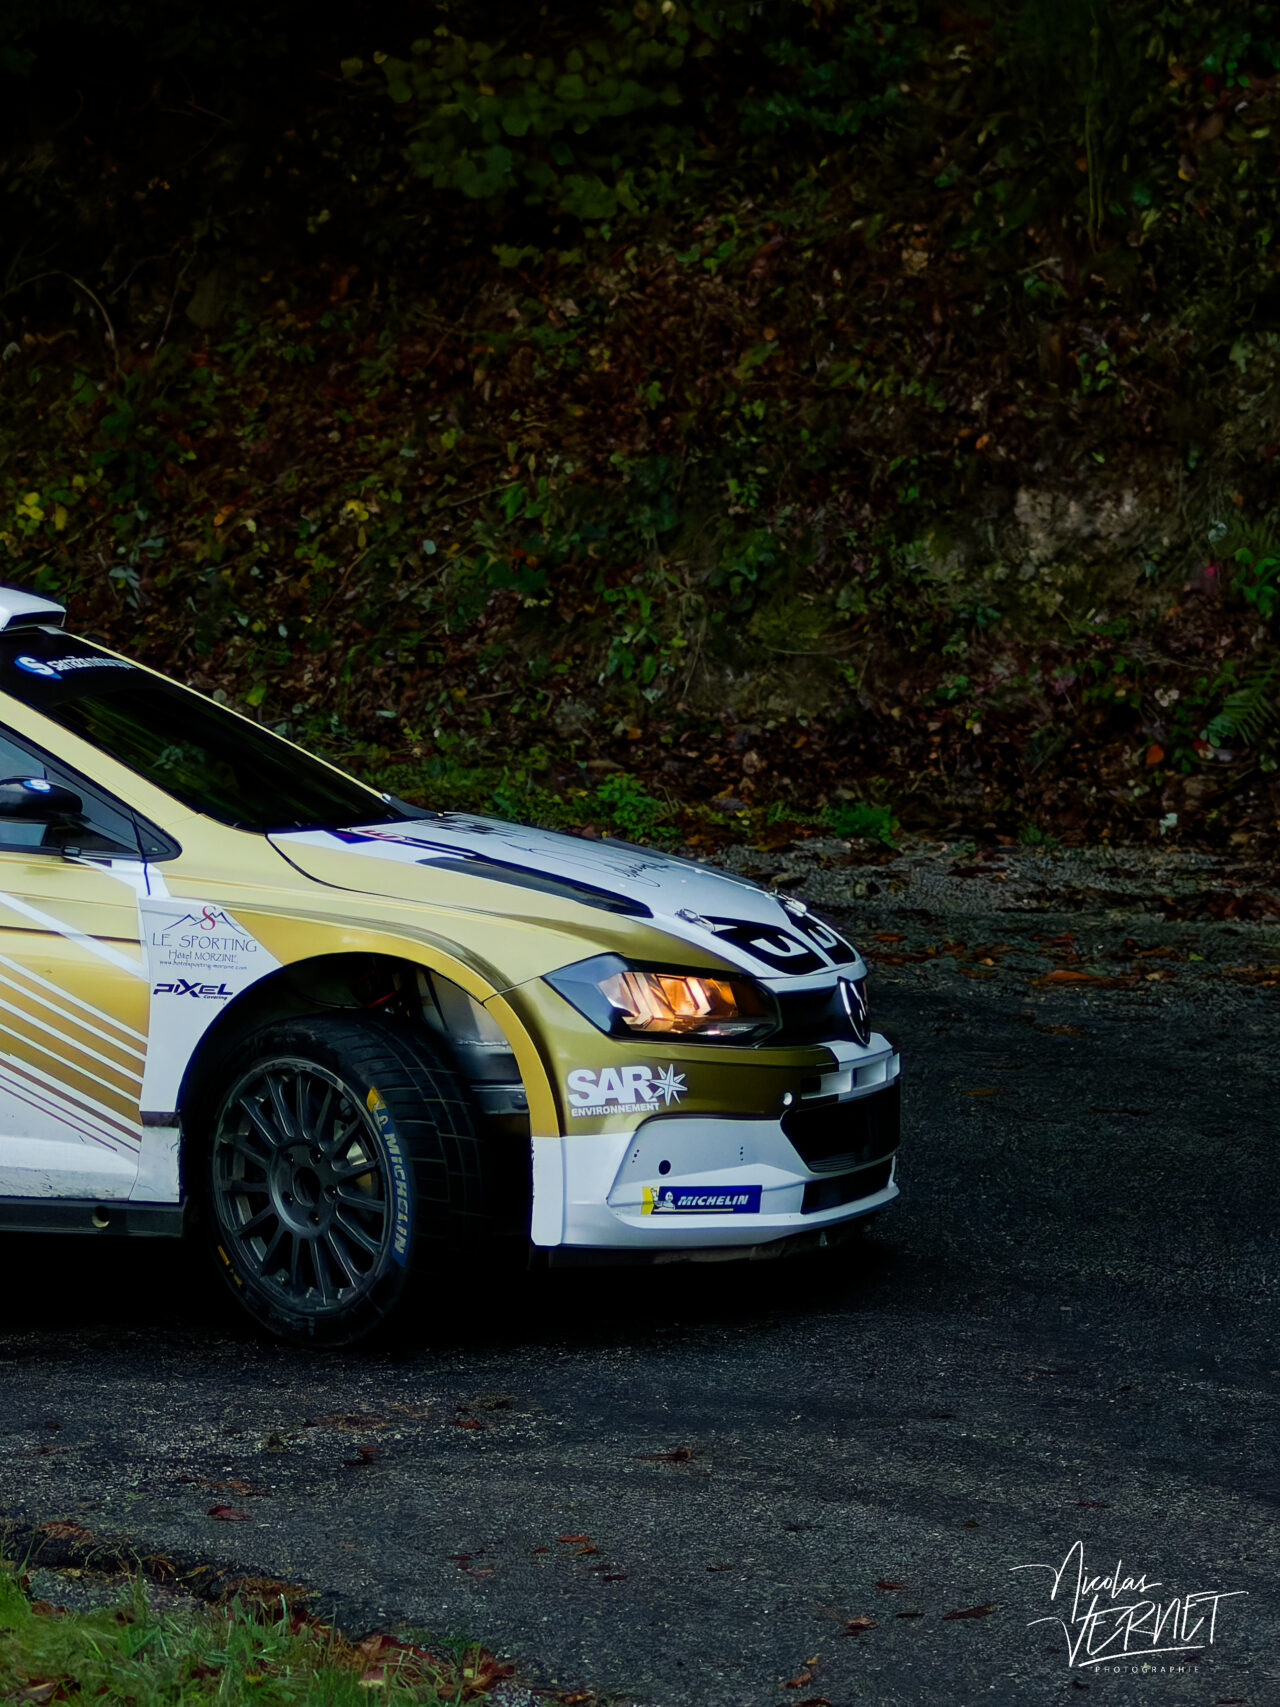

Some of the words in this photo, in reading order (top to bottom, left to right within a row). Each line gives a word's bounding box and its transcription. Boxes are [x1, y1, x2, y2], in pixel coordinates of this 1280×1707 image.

[152, 932, 173, 947] LE
[179, 935, 257, 953] SPORTING
[194, 952, 237, 963] MORZINE
[567, 1065, 659, 1108] SAR
[571, 1102, 660, 1118] ENVIRONNEMENT
[383, 1133, 410, 1255] MICHELIN
[677, 1195, 750, 1206] MICHELIN
